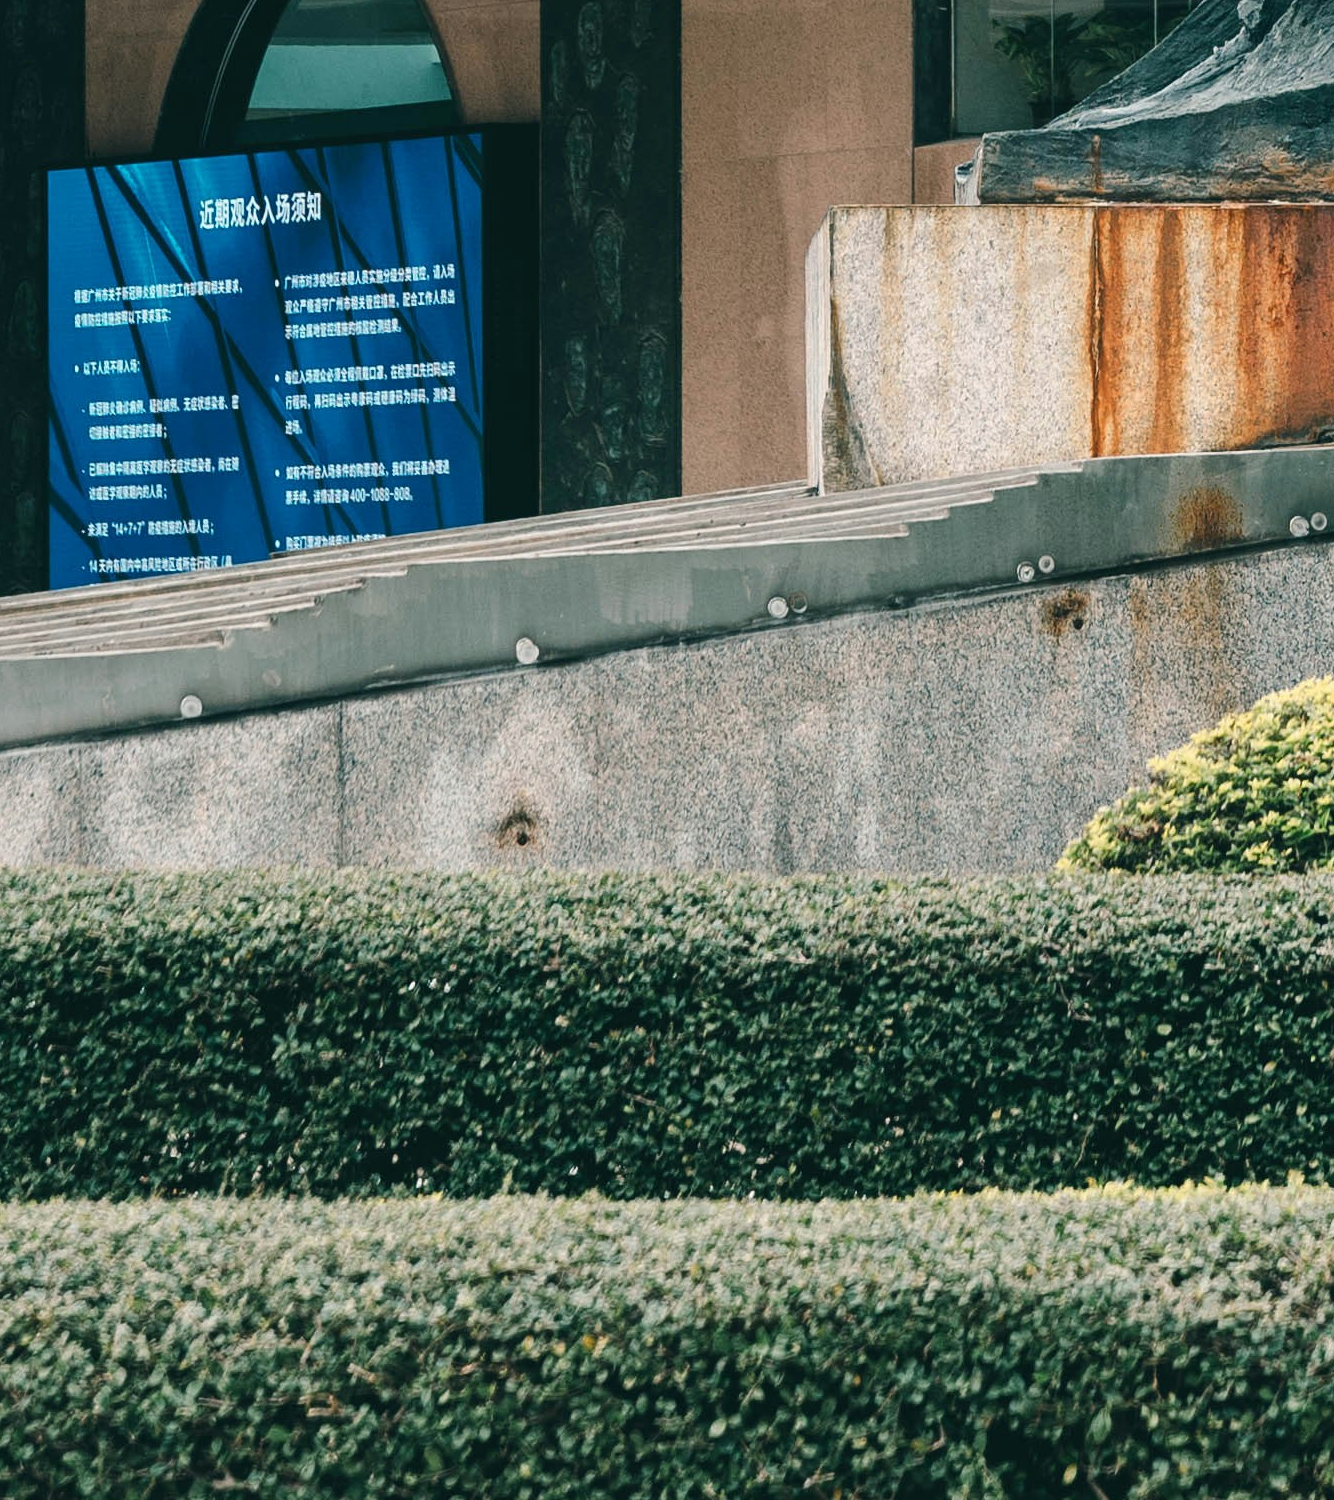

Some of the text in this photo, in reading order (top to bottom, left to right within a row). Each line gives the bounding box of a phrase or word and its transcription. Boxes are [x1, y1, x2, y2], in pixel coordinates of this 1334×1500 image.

[200, 192, 321, 229] 近期观众入场须知
